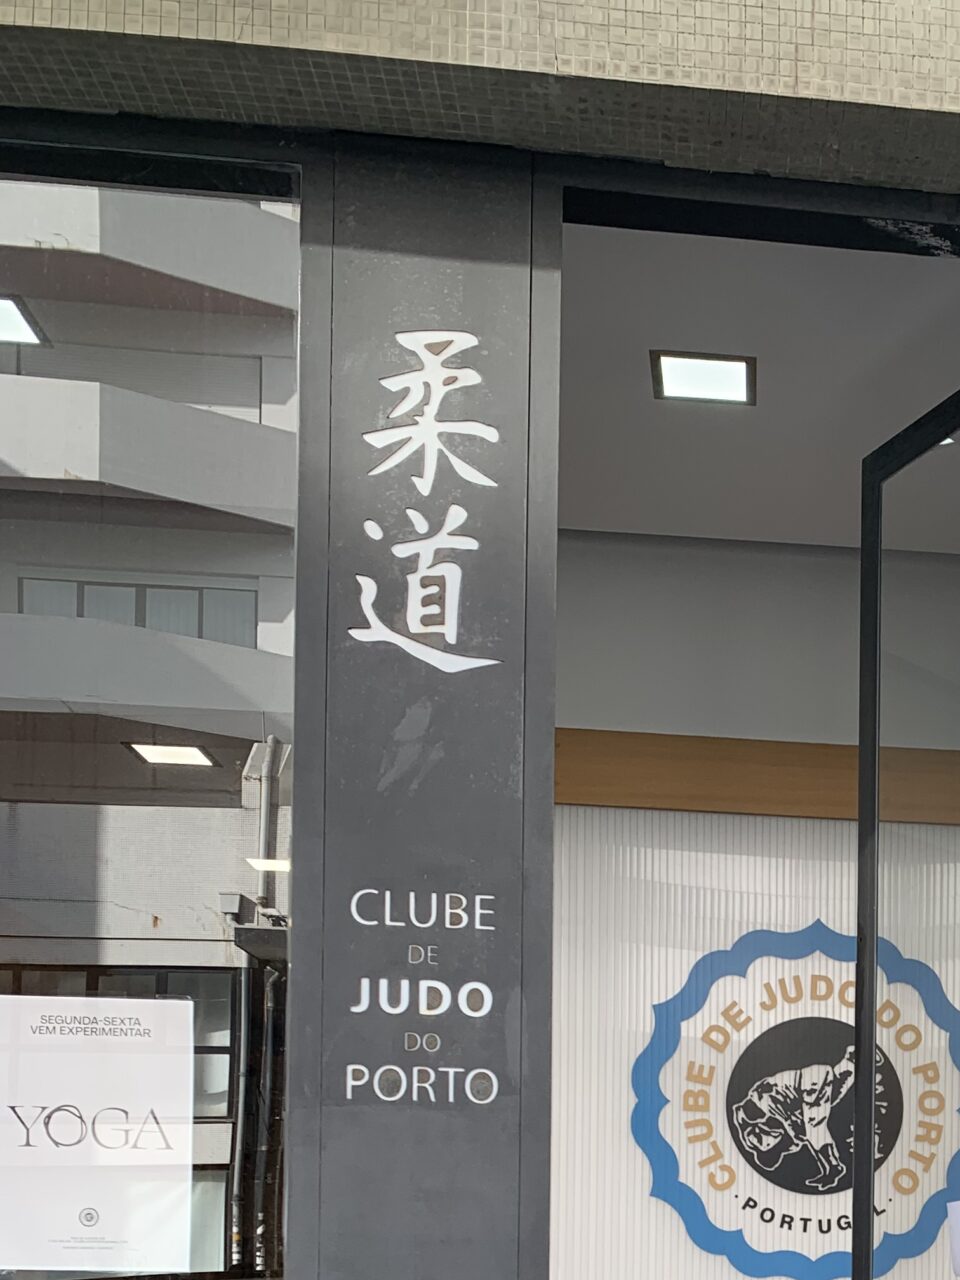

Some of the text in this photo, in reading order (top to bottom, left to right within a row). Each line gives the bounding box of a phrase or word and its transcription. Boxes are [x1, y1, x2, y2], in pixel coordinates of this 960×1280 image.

[347, 330, 504, 673] 柔道
[350, 888, 496, 931] CLUBE
[408, 944, 440, 965] DE
[350, 977, 494, 1018] JUDO
[30, 1025, 152, 1038] VEM EXPERIMENTAR
[40, 1014, 142, 1027] SEGUNDA-SEXTA
[701, 1001, 753, 1054] DE
[876, 999, 923, 1052] DO
[404, 1032, 441, 1052] DO
[346, 1064, 499, 1104] PORTO
[7, 1104, 174, 1150] YOGA
[682, 1061, 736, 1192] CLUBE
[892, 1061, 946, 1195] PORTO
[741, 1196, 886, 1234] PORTUGL
